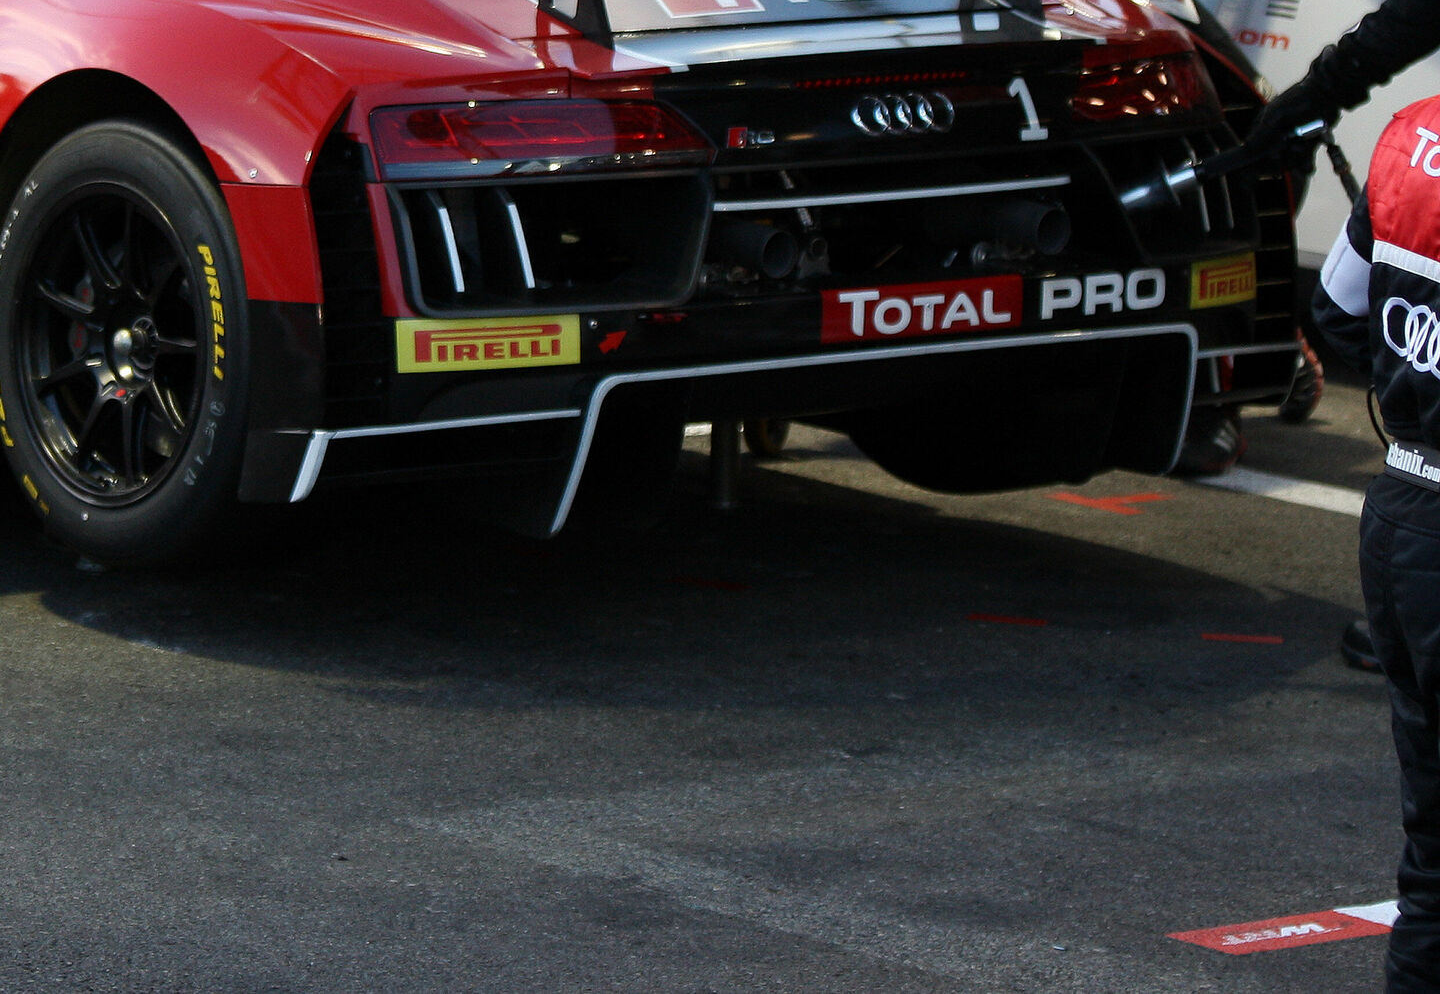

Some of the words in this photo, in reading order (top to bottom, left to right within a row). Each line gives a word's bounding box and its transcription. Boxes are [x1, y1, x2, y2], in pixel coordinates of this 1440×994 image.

[1007, 76, 1049, 141] 1
[197, 244, 225, 382] PIRELLI
[839, 290, 1012, 337] TOTAL
[1040, 268, 1166, 320] PRO
[1198, 261, 1254, 301] PIRELLI
[414, 323, 563, 363] PIRELLI
